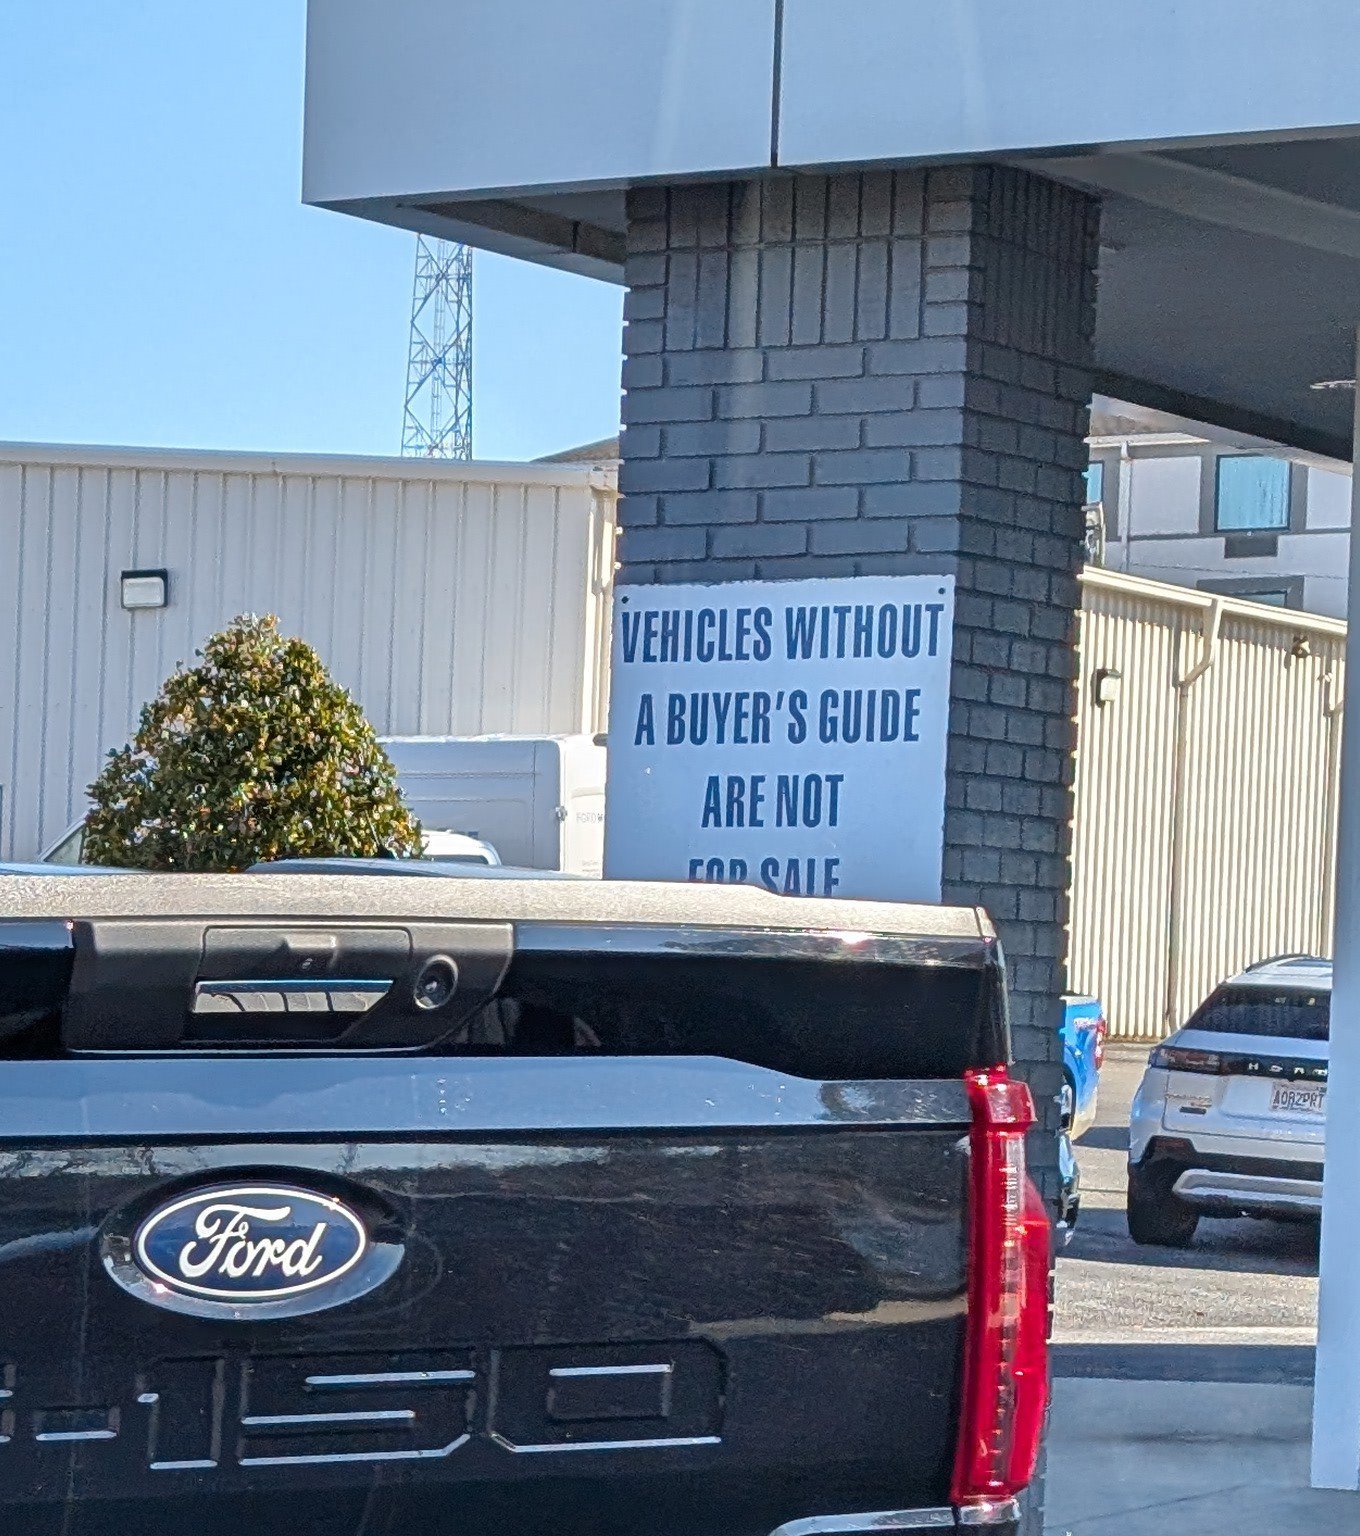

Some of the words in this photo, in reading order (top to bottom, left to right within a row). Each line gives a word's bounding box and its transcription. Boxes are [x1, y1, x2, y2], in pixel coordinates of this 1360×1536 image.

[621, 606, 773, 664] VEHICLES
[785, 603, 944, 660] WITHOUT
[633, 693, 656, 747] A
[665, 689, 808, 746] BUYER'S
[818, 688, 922, 744] GUIDE
[700, 775, 765, 828] ARE
[775, 773, 845, 828] NOT
[179, 1203, 328, 1278] Ford
